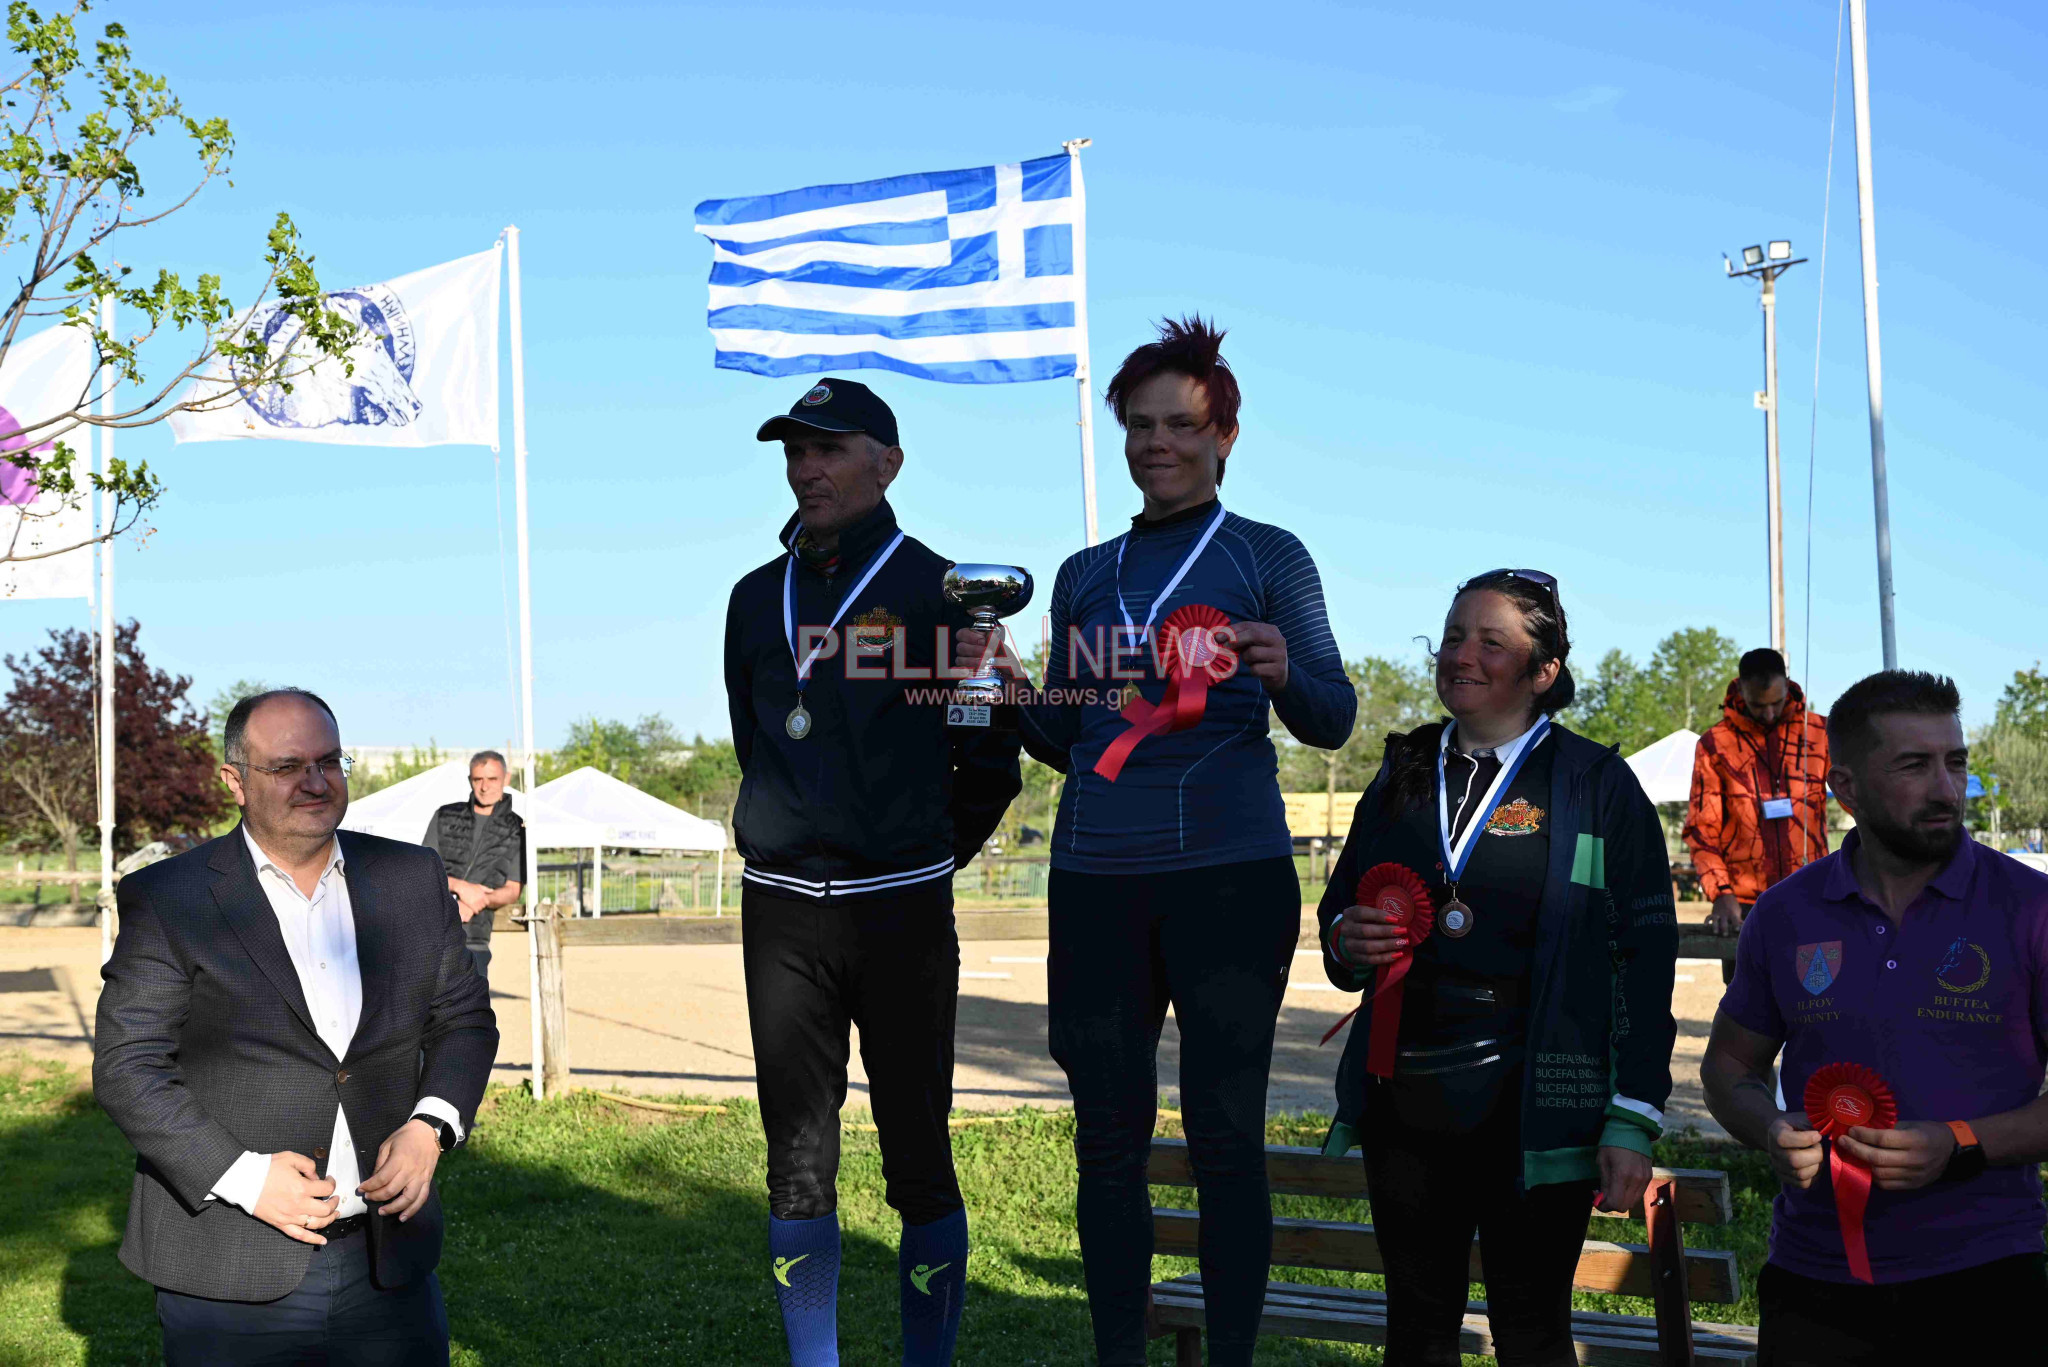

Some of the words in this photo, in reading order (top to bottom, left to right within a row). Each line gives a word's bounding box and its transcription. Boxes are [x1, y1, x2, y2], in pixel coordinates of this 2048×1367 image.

[1797, 997, 1835, 1011] ILFOV
[1934, 995, 1990, 1009] BUFTEA
[1917, 1007, 2004, 1024] ENDURANCE
[1536, 1052, 1576, 1064] BUCEFAL
[1536, 1067, 1578, 1079] BUCEFAL
[1536, 1082, 1579, 1094] BUCEFAL
[1536, 1097, 1578, 1109] BUCEFAL
